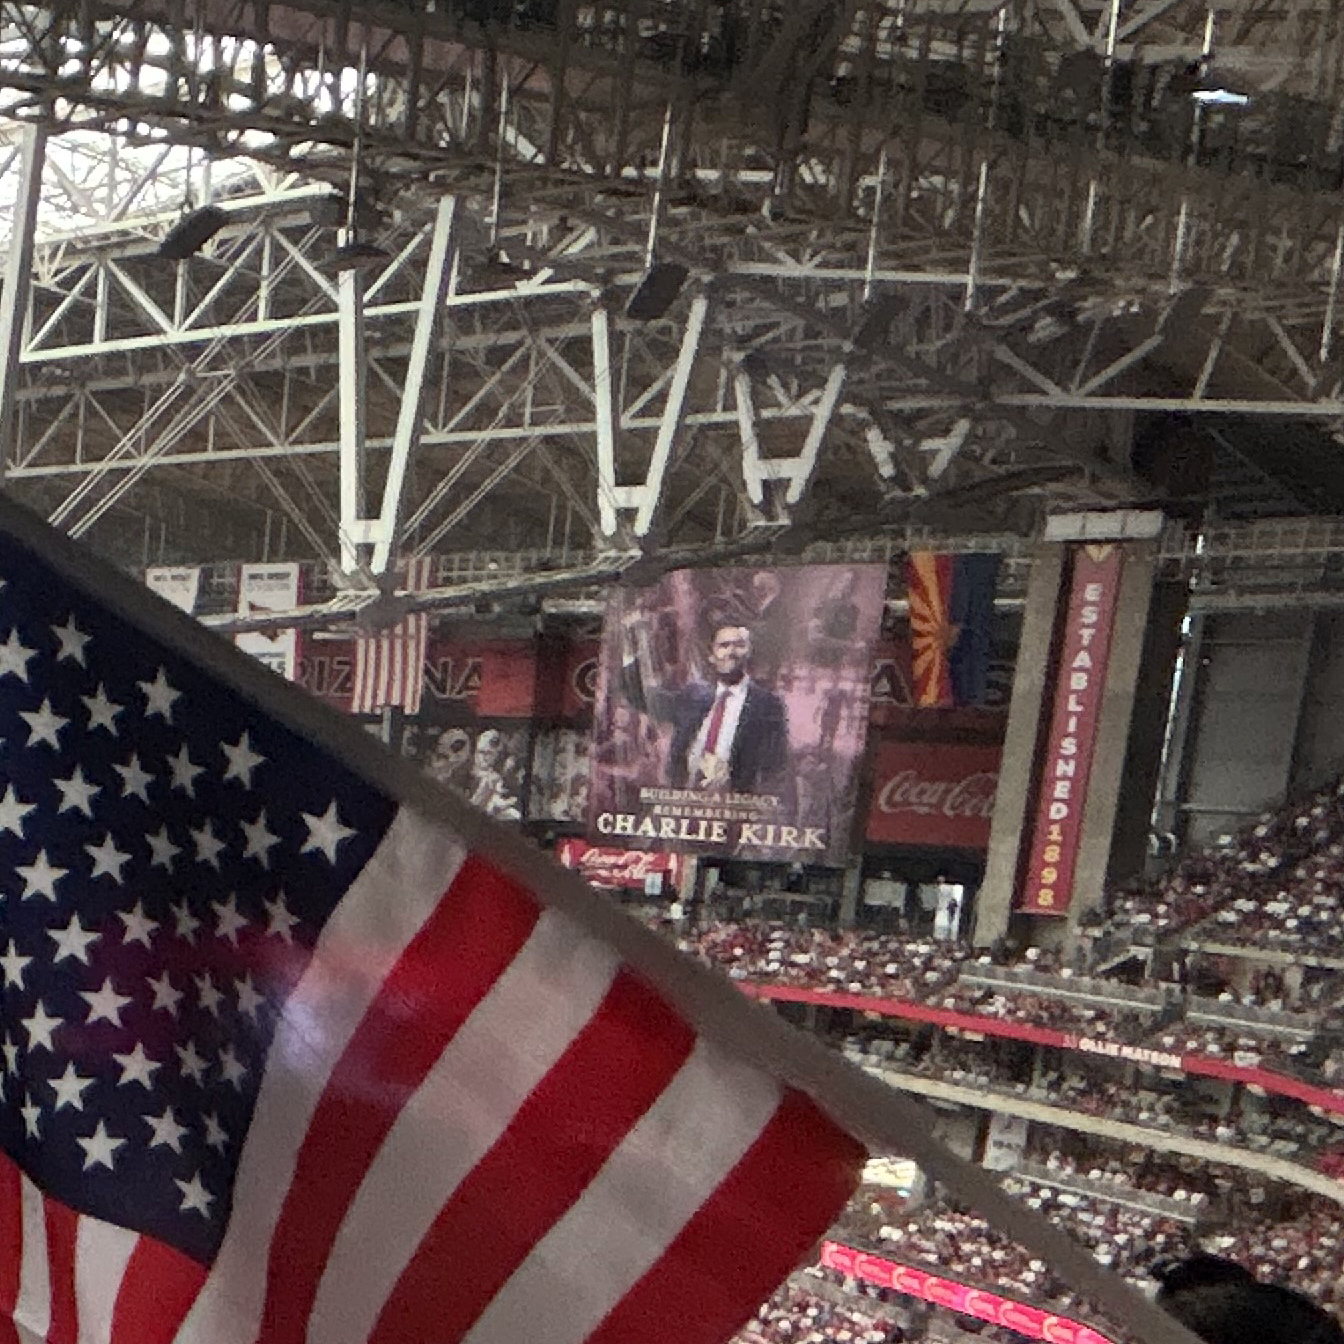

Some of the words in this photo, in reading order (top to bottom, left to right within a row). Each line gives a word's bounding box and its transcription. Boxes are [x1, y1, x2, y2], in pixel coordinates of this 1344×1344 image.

[1048, 582, 1103, 821] ESTABLISHED
[640, 786, 708, 802] BUILDING
[653, 804, 759, 821] REMEMBERING
[597, 812, 728, 843] CHARLIE
[738, 823, 827, 850] KIRK
[1037, 824, 1063, 906] 1898
